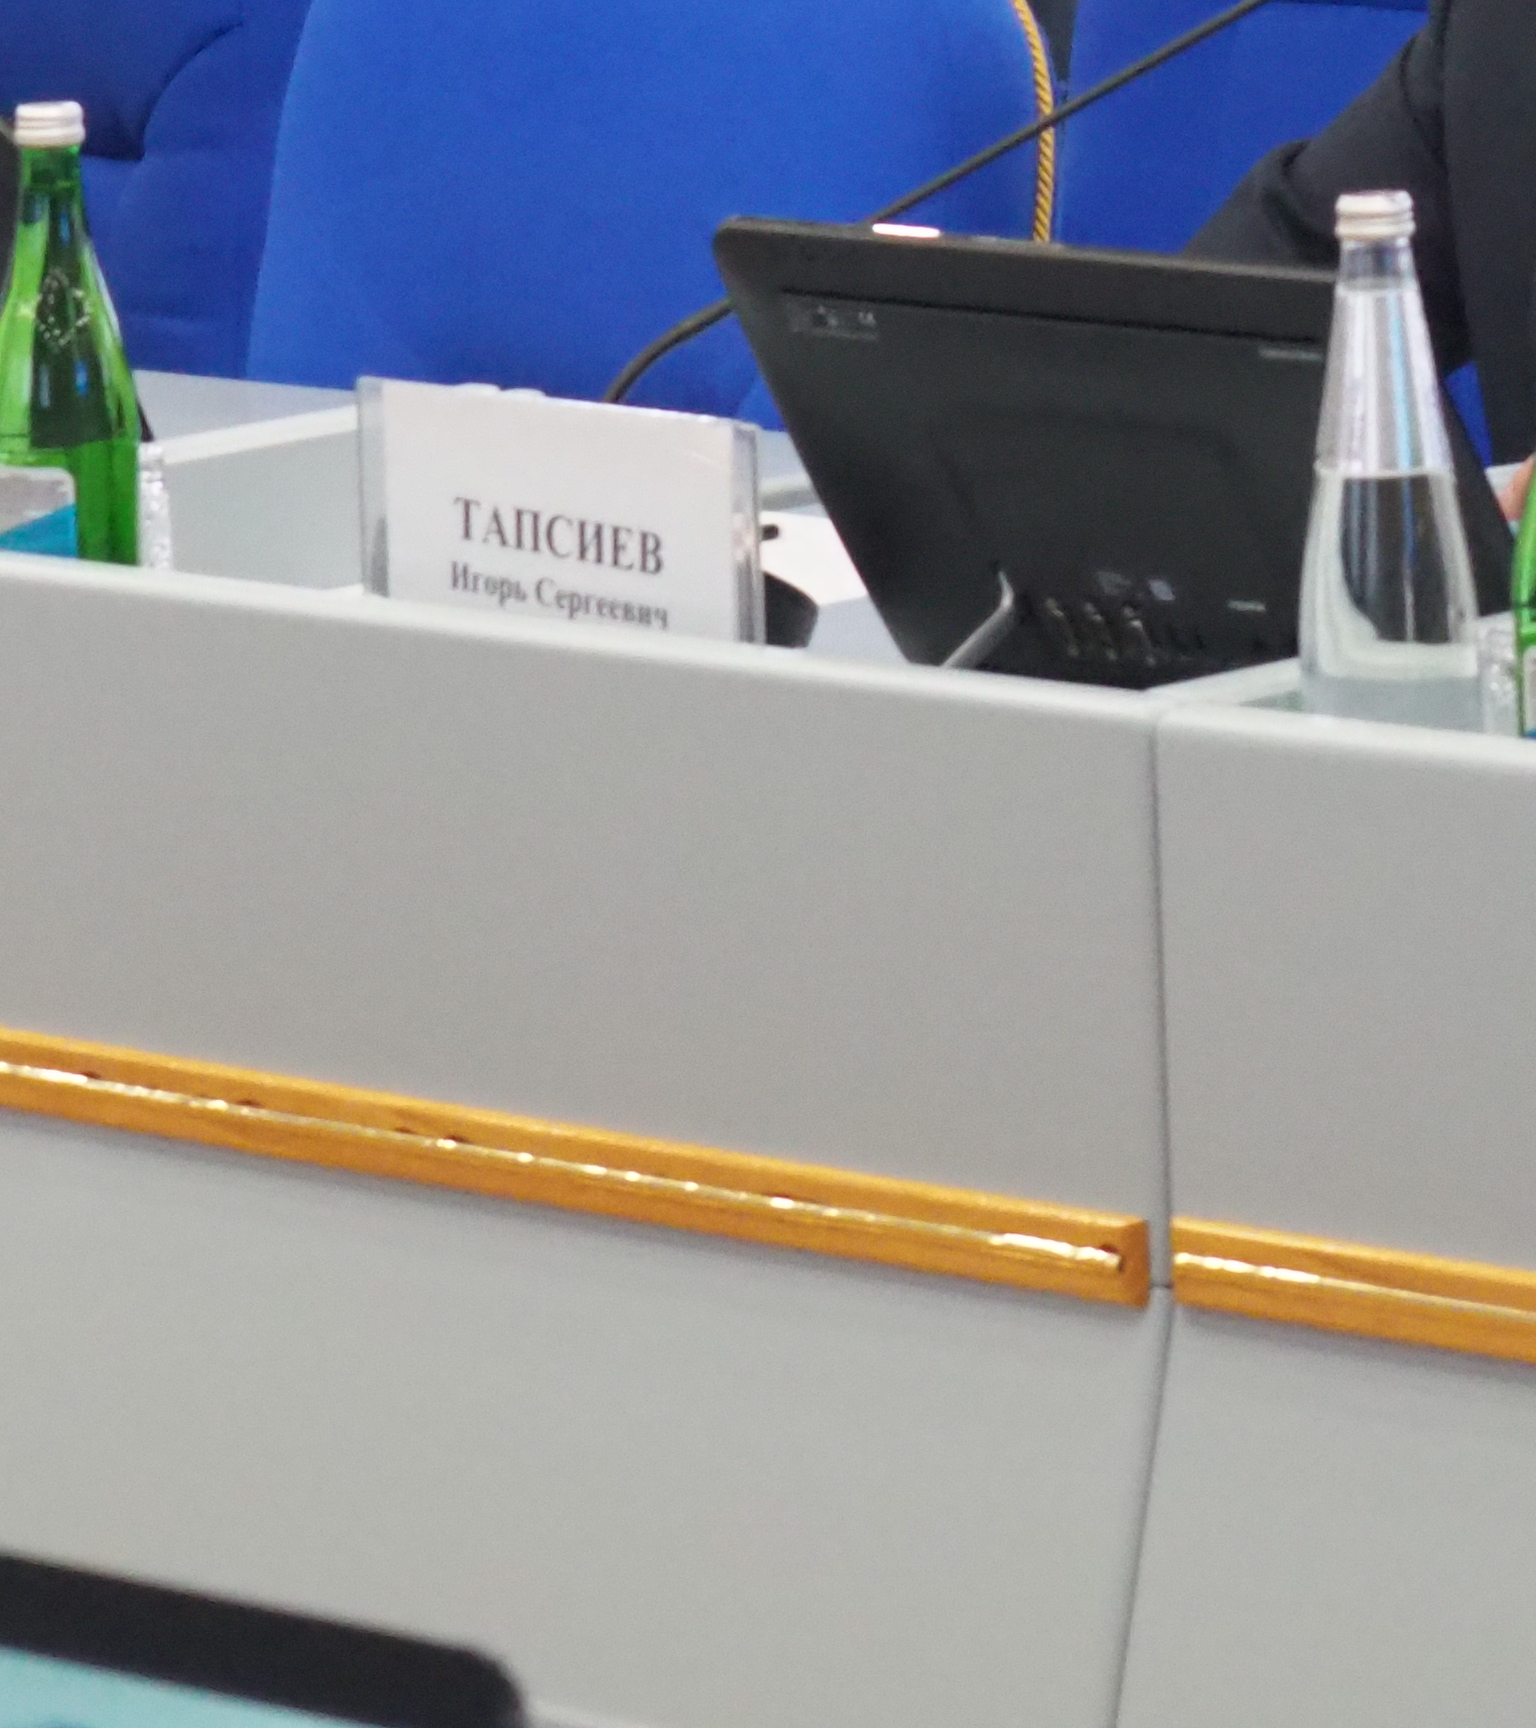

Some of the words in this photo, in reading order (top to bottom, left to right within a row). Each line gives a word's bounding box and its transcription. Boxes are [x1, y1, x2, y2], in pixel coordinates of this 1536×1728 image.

[454, 497, 664, 575] ТАПСИЕВ
[450, 562, 527, 607] Игорь
[535, 578, 669, 629] Сергеевич
